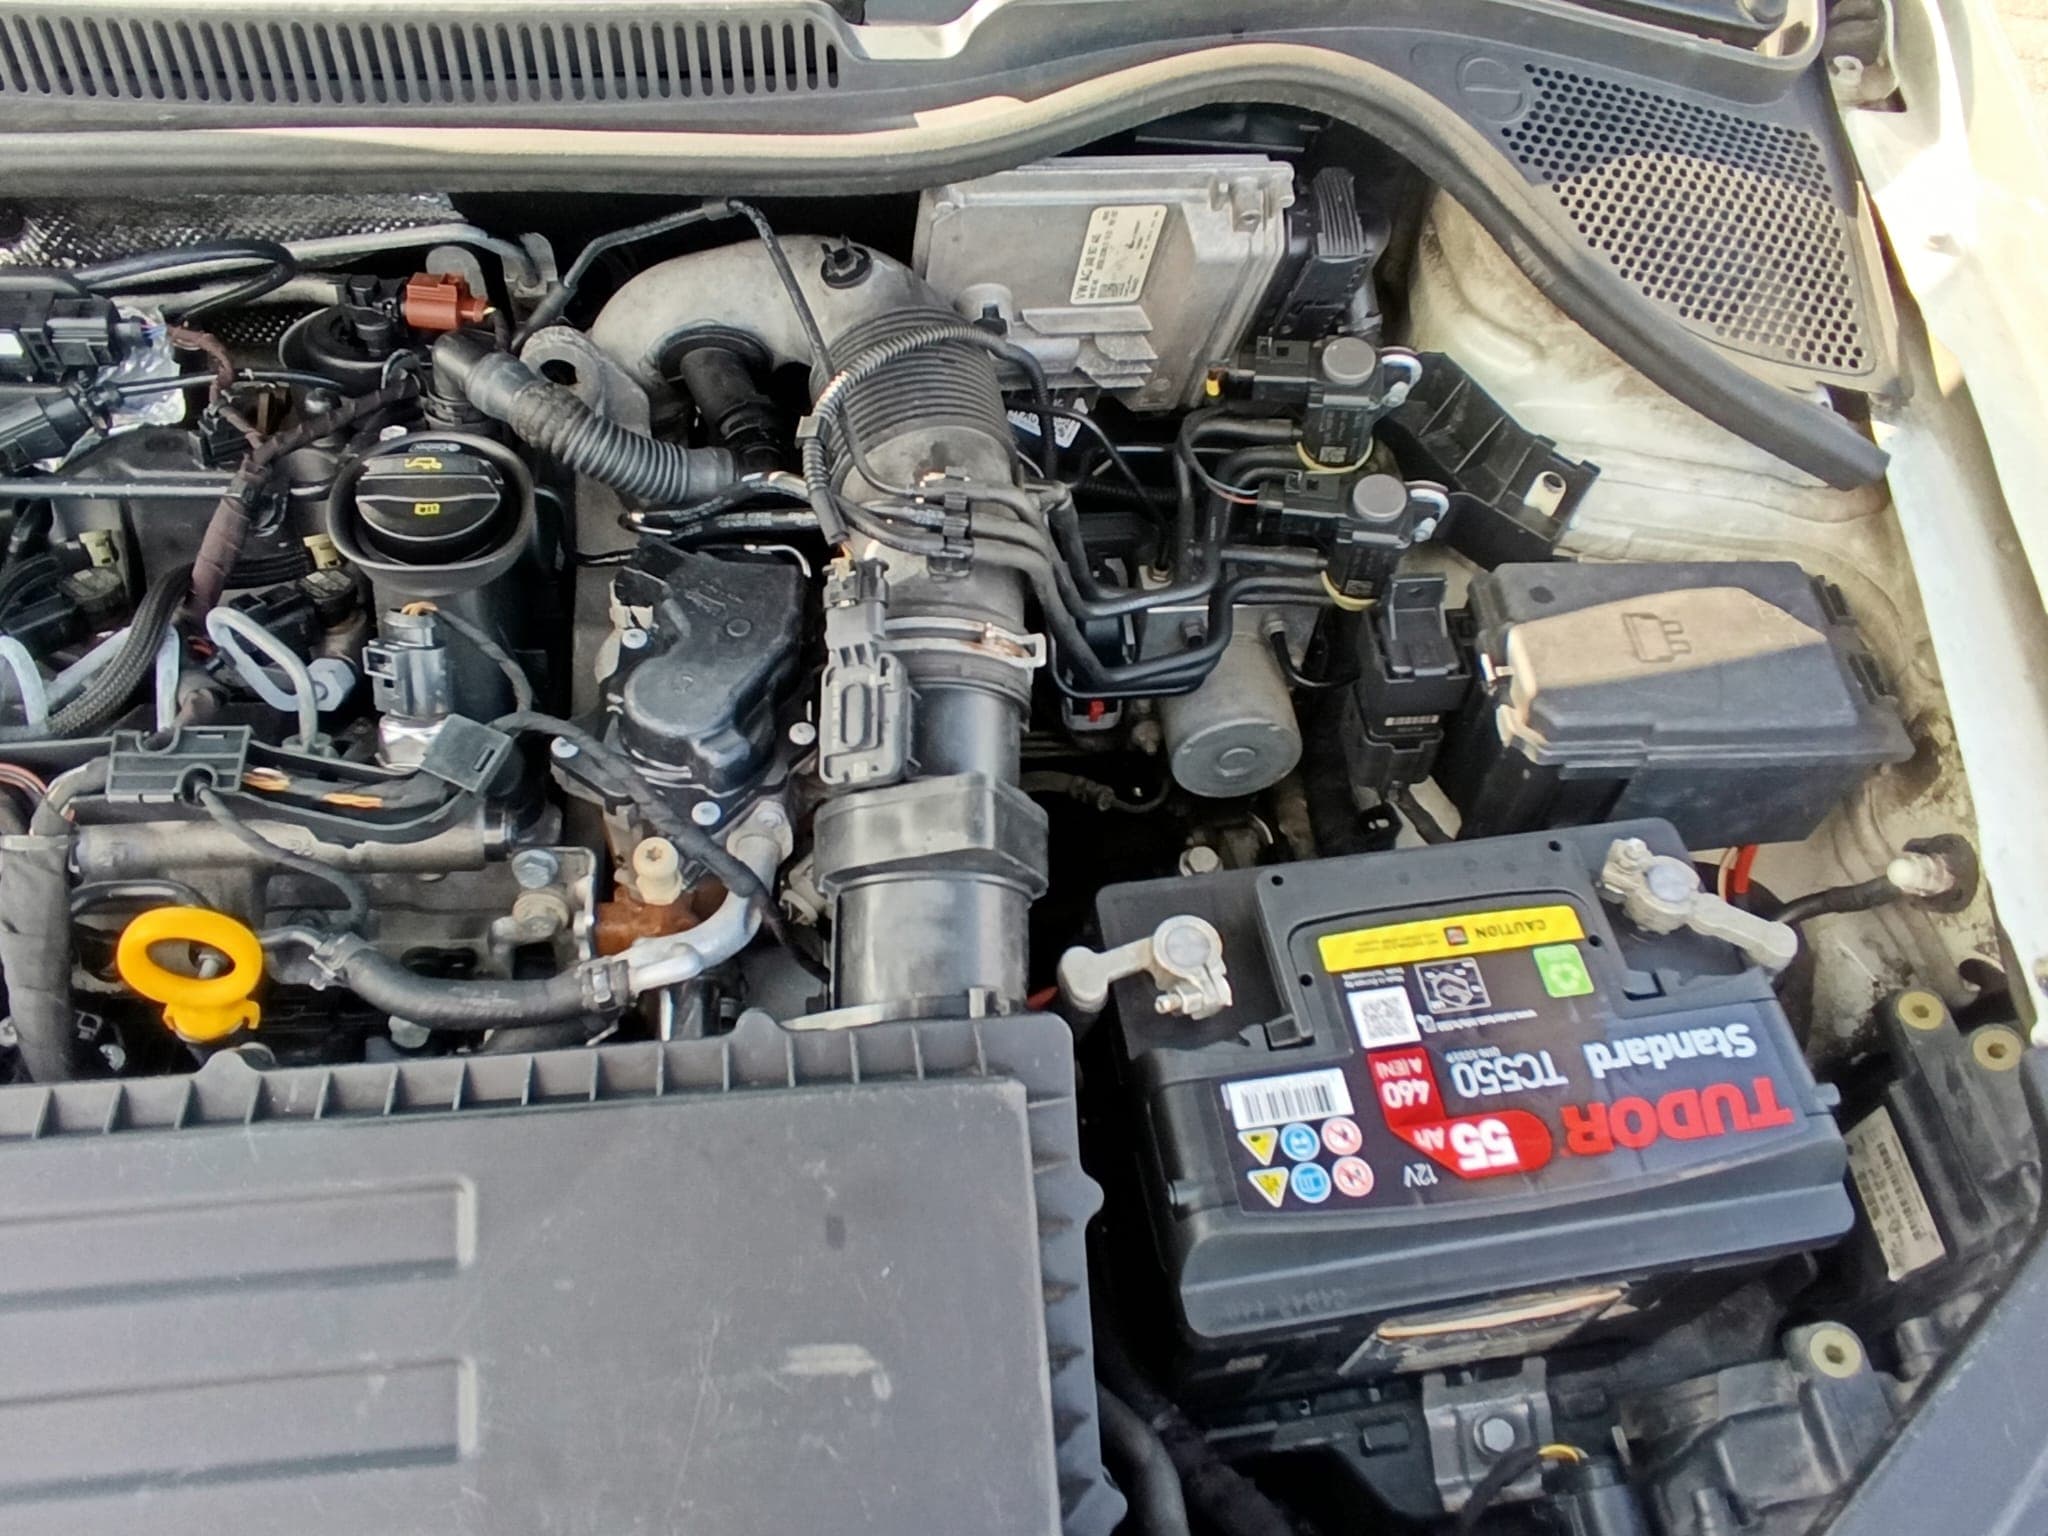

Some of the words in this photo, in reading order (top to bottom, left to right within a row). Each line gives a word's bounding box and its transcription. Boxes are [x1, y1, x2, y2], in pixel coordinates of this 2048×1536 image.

[1475, 919, 1547, 937] CAUTION
[1582, 1023, 1757, 1079] Standard
[1451, 1050, 1569, 1098] TC550
[1381, 1079, 1430, 1109] 460
[1560, 1075, 1795, 1156] TUDOR
[1413, 1127, 1445, 1151] Ah
[1450, 1118, 1519, 1171] 55
[1403, 1162, 1439, 1188] 12V
